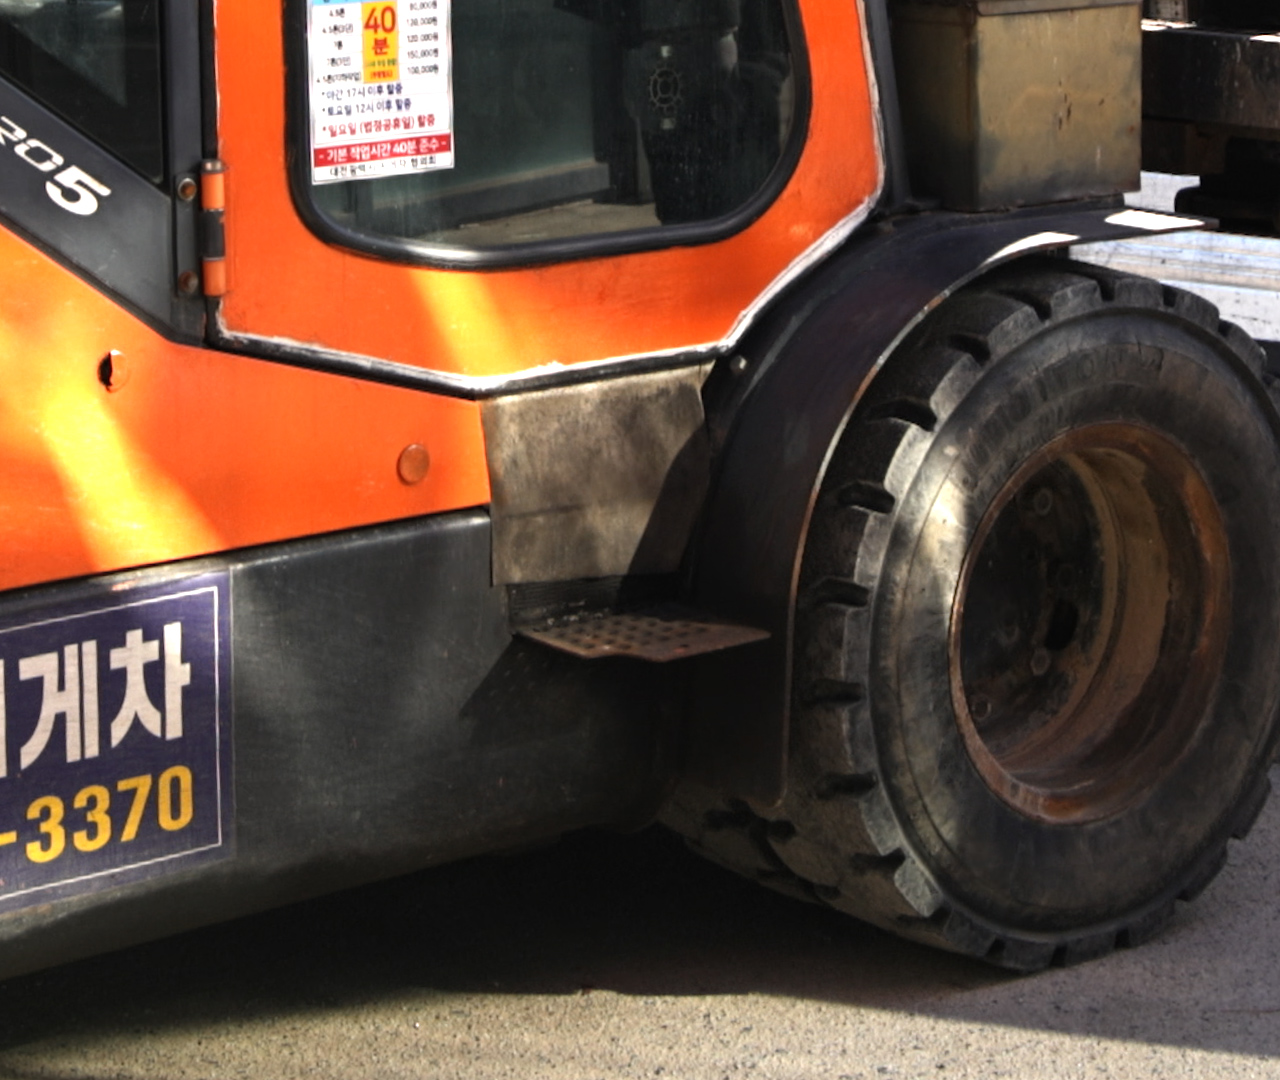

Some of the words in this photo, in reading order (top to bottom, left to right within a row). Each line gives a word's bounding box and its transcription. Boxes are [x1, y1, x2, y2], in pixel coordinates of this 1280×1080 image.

[364, 5, 396, 34] 40
[372, 37, 390, 56] 분
[328, 122, 357, 137] 일요일
[326, 147, 348, 162] 기본
[350, 142, 391, 160] 작업시간
[393, 140, 416, 154] 40분
